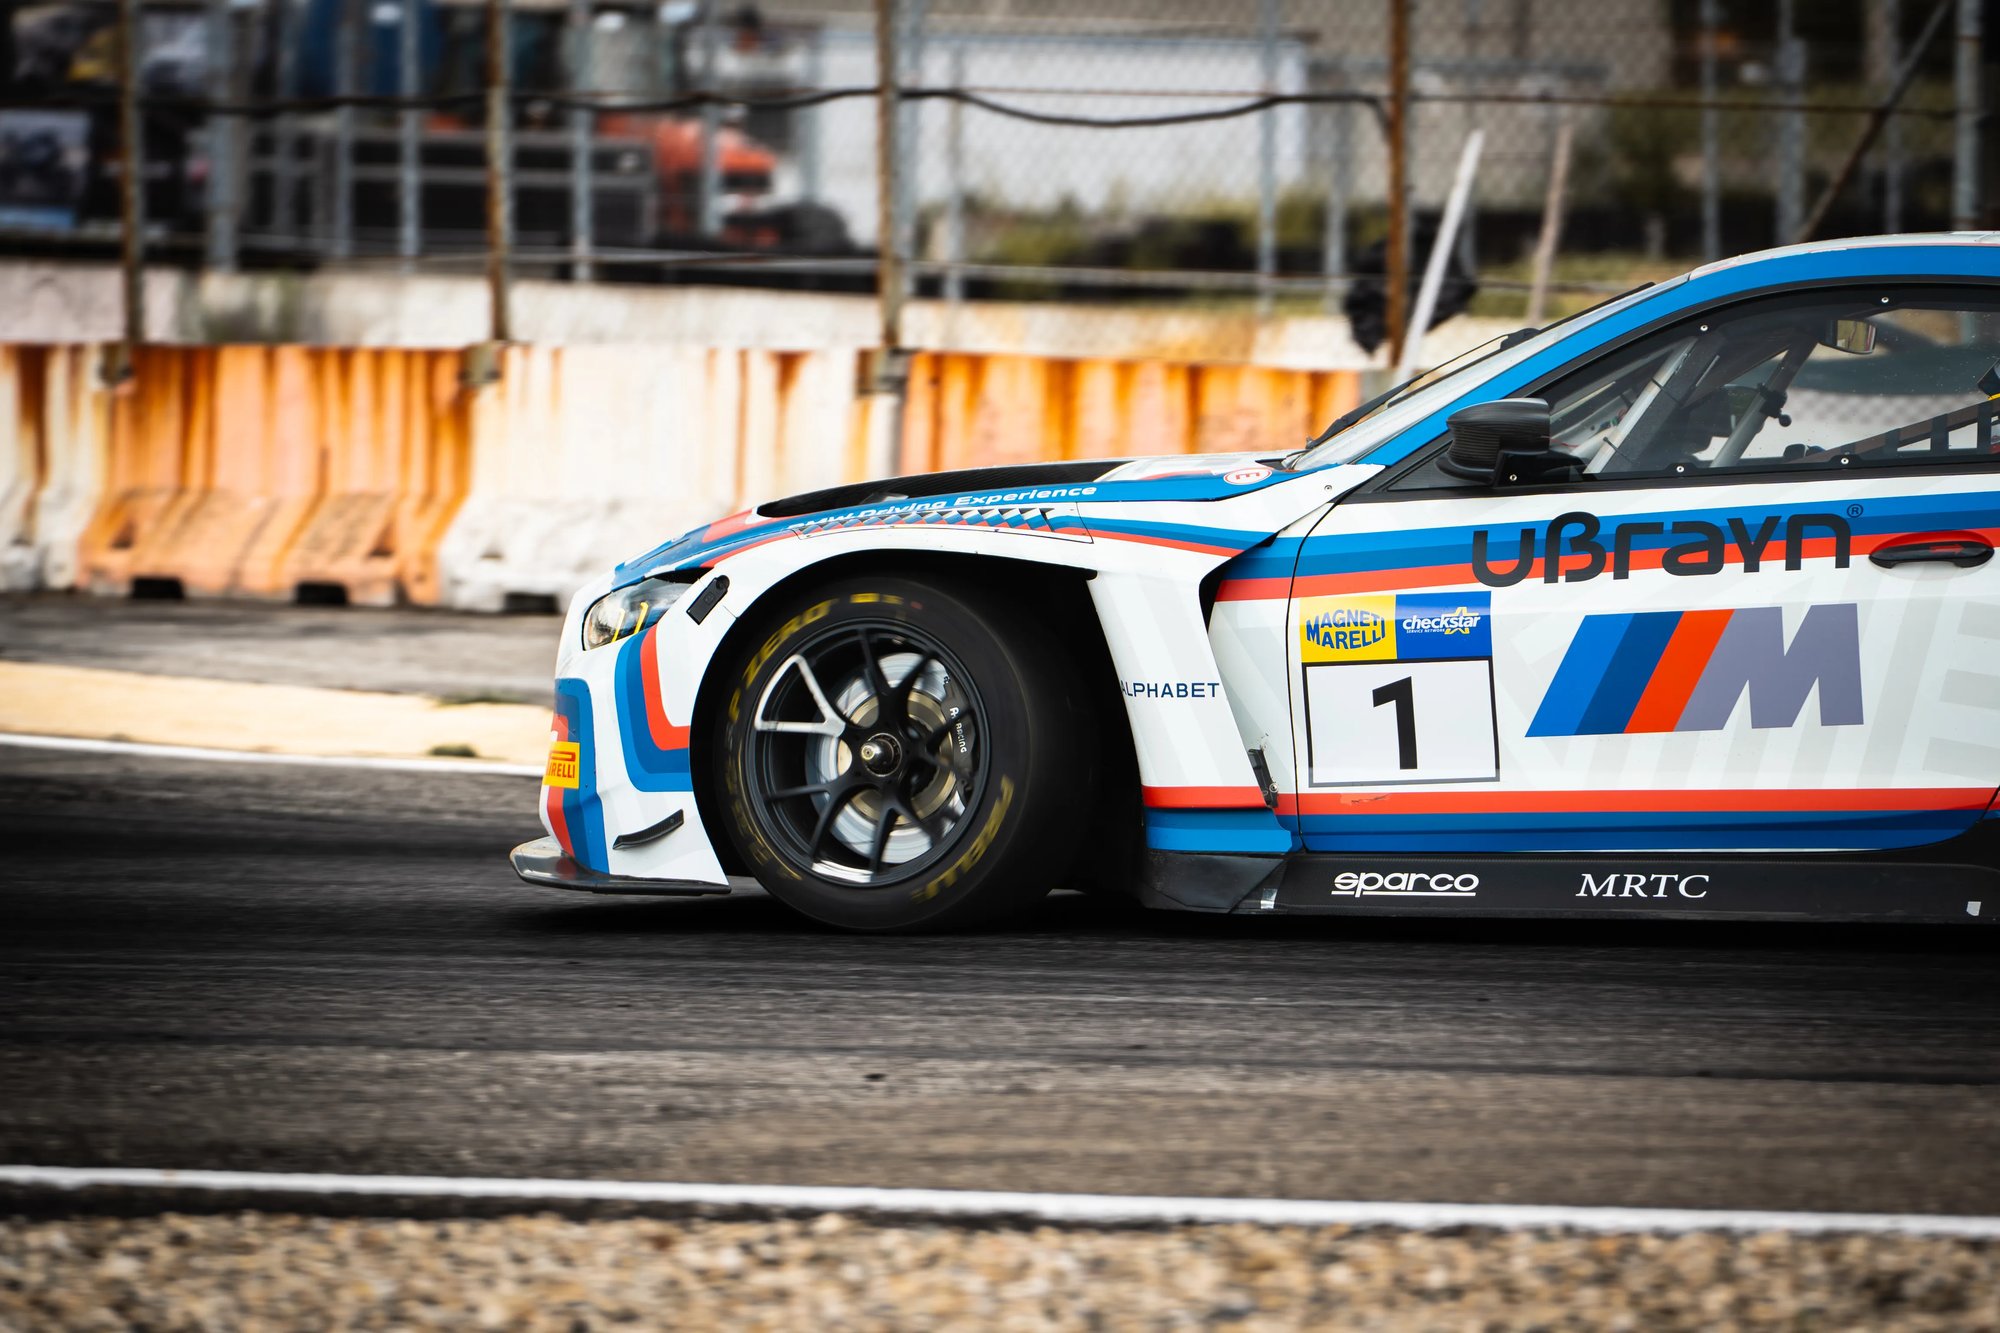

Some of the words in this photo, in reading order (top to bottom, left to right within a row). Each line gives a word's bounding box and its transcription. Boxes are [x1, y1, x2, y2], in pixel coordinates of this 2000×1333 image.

[855, 501, 946, 518] Driving
[954, 486, 1098, 506] Experience
[1306, 609, 1386, 635] MAGNETI
[1306, 618, 1386, 650] MARELLI
[1402, 614, 1481, 630] checkstar
[1120, 680, 1220, 698] ALPHABET
[1371, 675, 1418, 770] 1
[1332, 872, 1480, 898] sparco
[1575, 873, 1710, 898] MRTC
